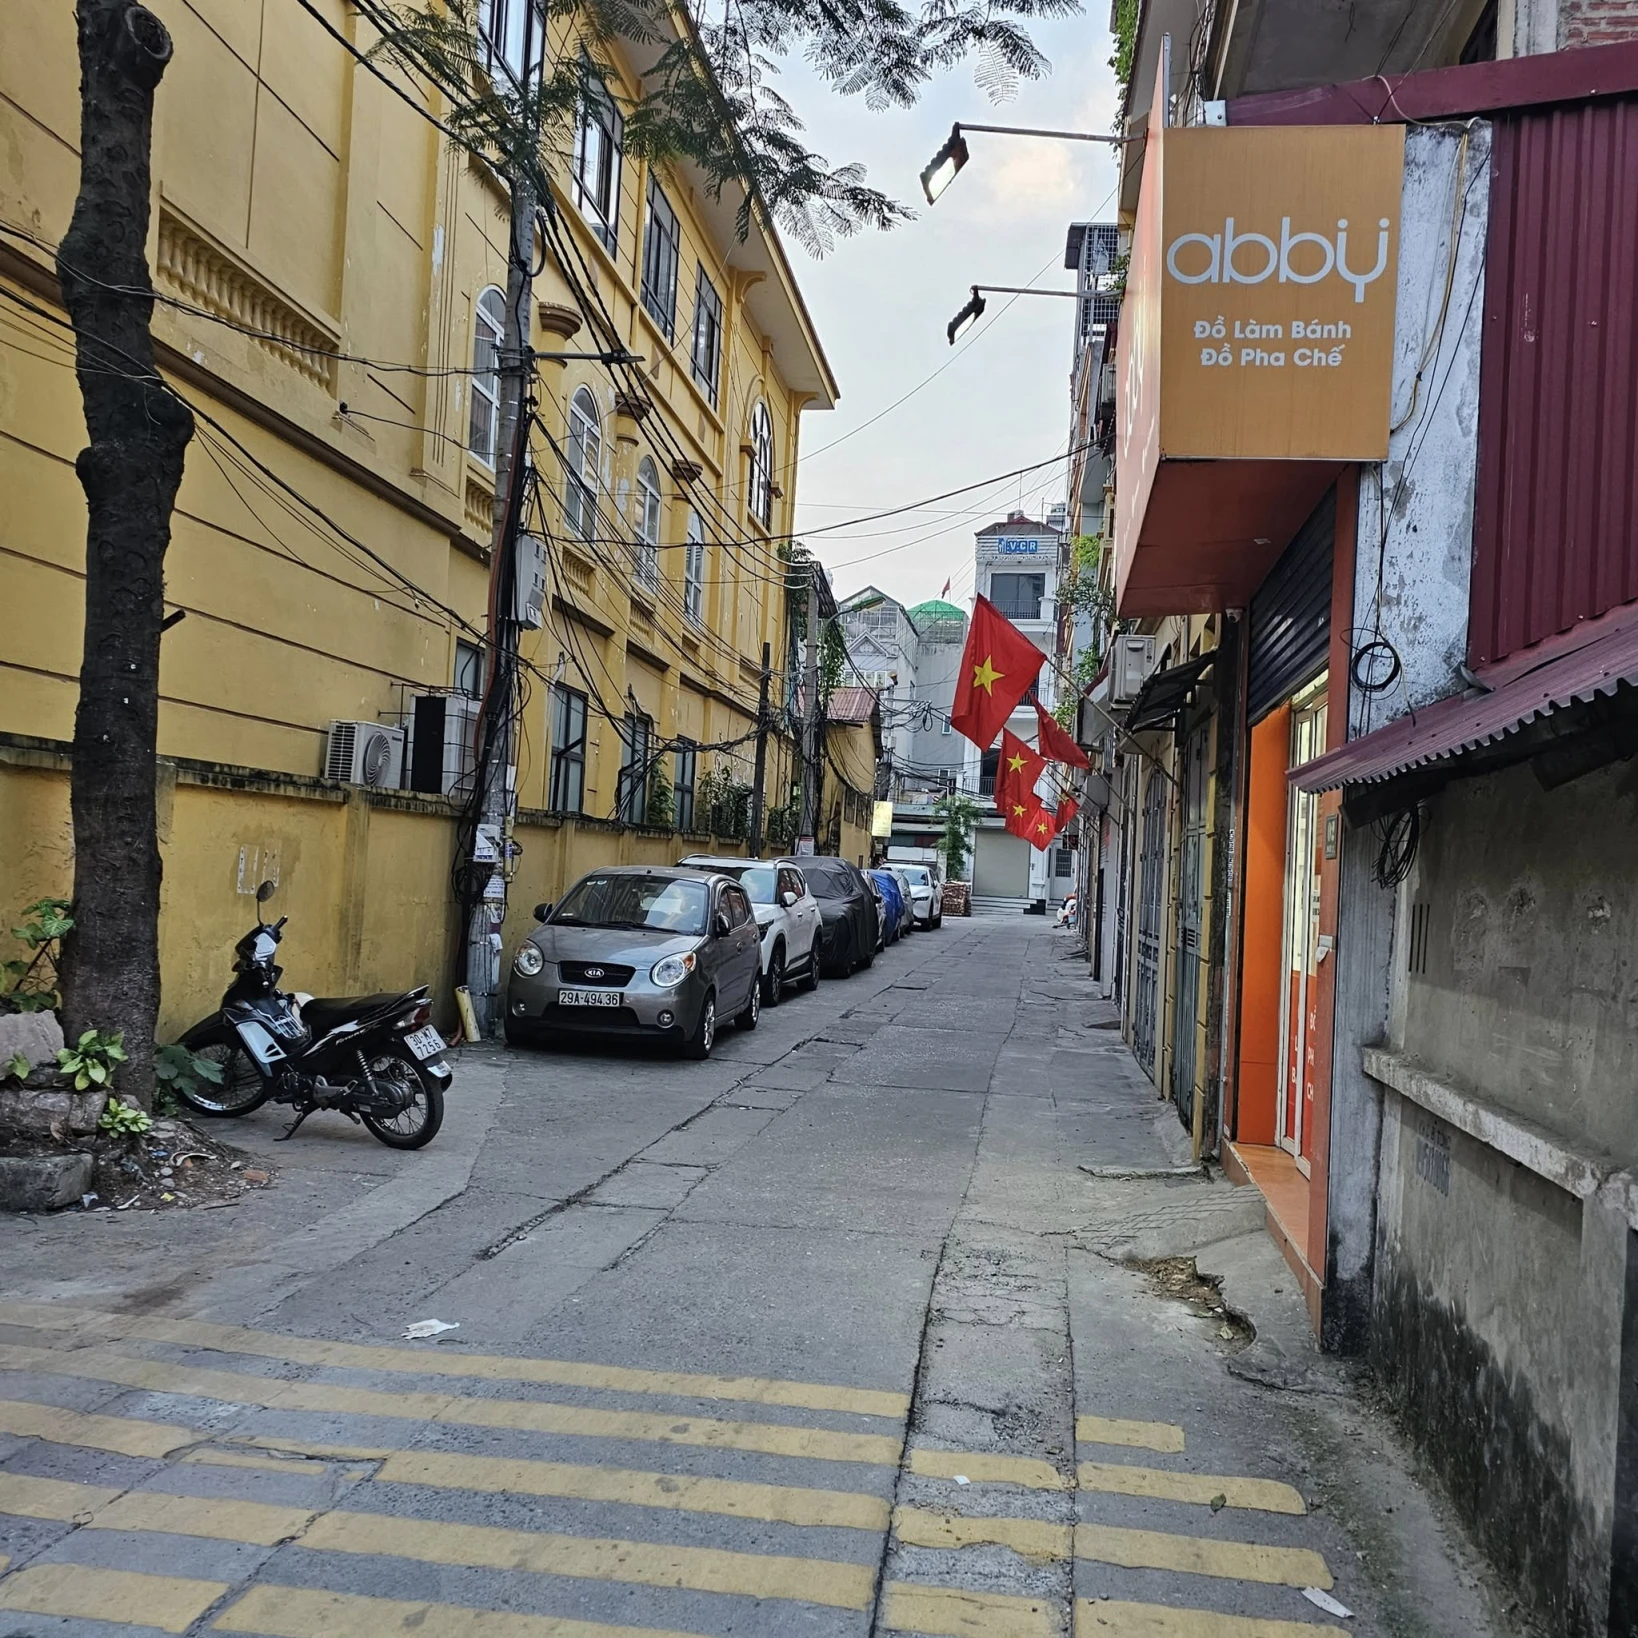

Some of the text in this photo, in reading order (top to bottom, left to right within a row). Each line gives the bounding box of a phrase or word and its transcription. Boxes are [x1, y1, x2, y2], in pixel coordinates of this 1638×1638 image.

[1166, 217, 1390, 303] abby
[1193, 315, 1352, 339] Đồ Làm Bánh
[1201, 342, 1346, 367] Đồ Pha Chế
[1008, 541, 1037, 551] VCR
[560, 992, 619, 1006] 29A-494.36
[417, 1039, 442, 1057] 7256
